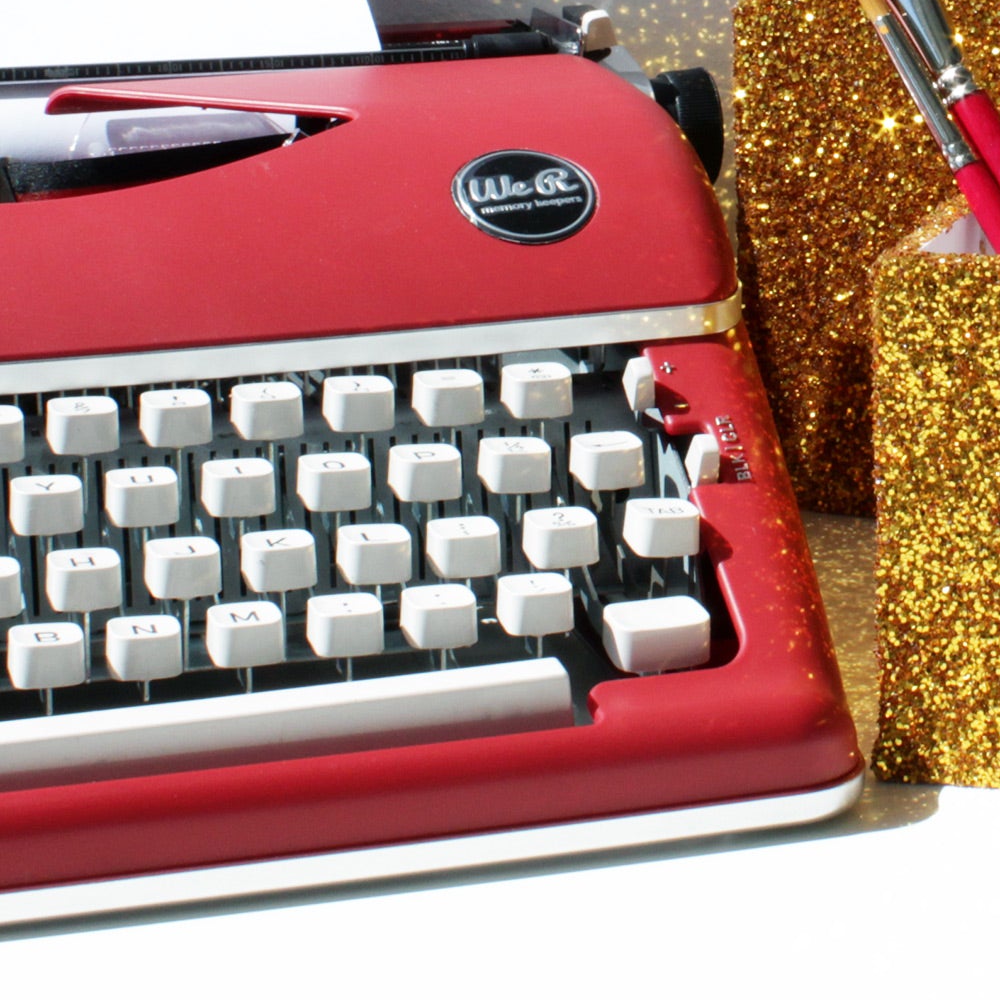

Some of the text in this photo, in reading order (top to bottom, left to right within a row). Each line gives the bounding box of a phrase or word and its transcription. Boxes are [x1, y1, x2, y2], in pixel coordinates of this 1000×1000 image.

[469, 167, 580, 202] We R
[480, 195, 583, 216] memory keepers
[413, 451, 436, 460] P
[322, 460, 346, 470] O
[129, 474, 154, 485] U
[35, 481, 55, 491] Y
[265, 536, 289, 548] K
[183, 545, 197, 556] J
[70, 556, 96, 568] H
[229, 610, 261, 623] M
[132, 624, 158, 635] N
[34, 631, 60, 643] B
